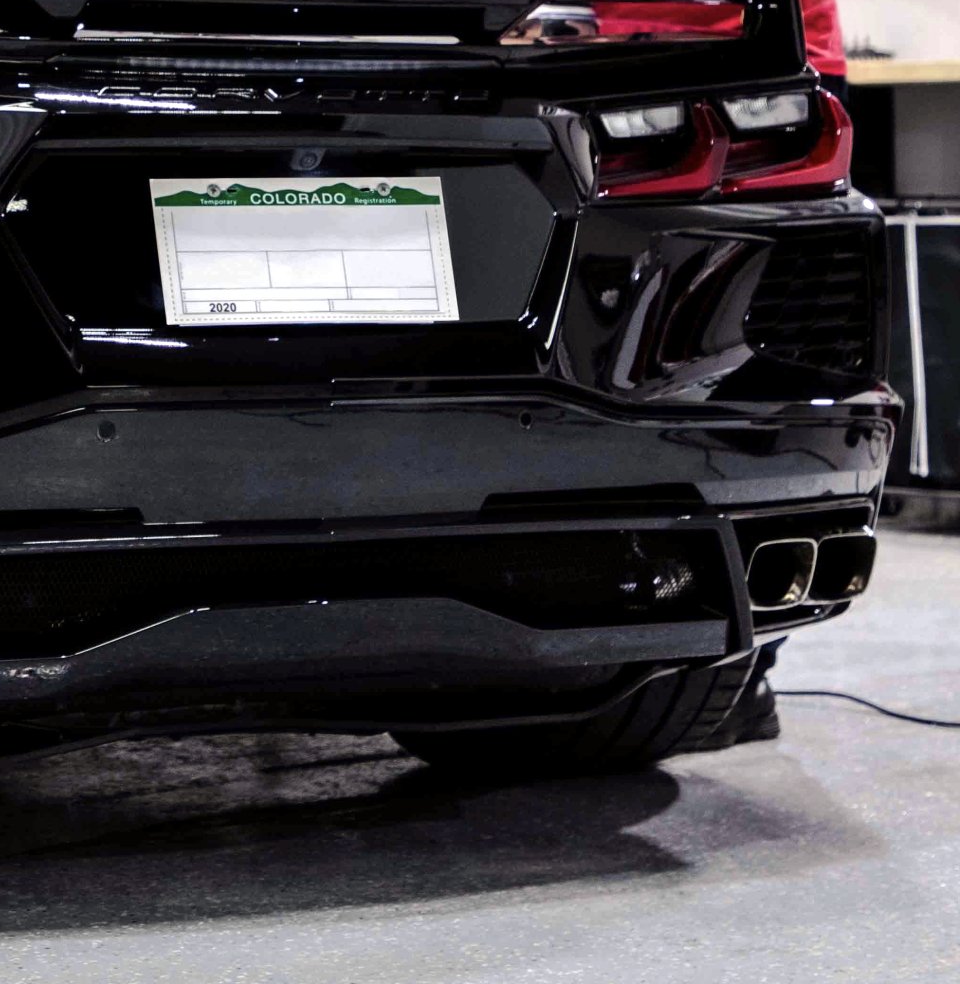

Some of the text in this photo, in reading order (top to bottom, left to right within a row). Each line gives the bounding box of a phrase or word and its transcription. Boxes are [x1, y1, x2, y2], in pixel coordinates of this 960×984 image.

[200, 192, 397, 206] Temporary COLORADO Registration
[209, 302, 237, 313] 2020
